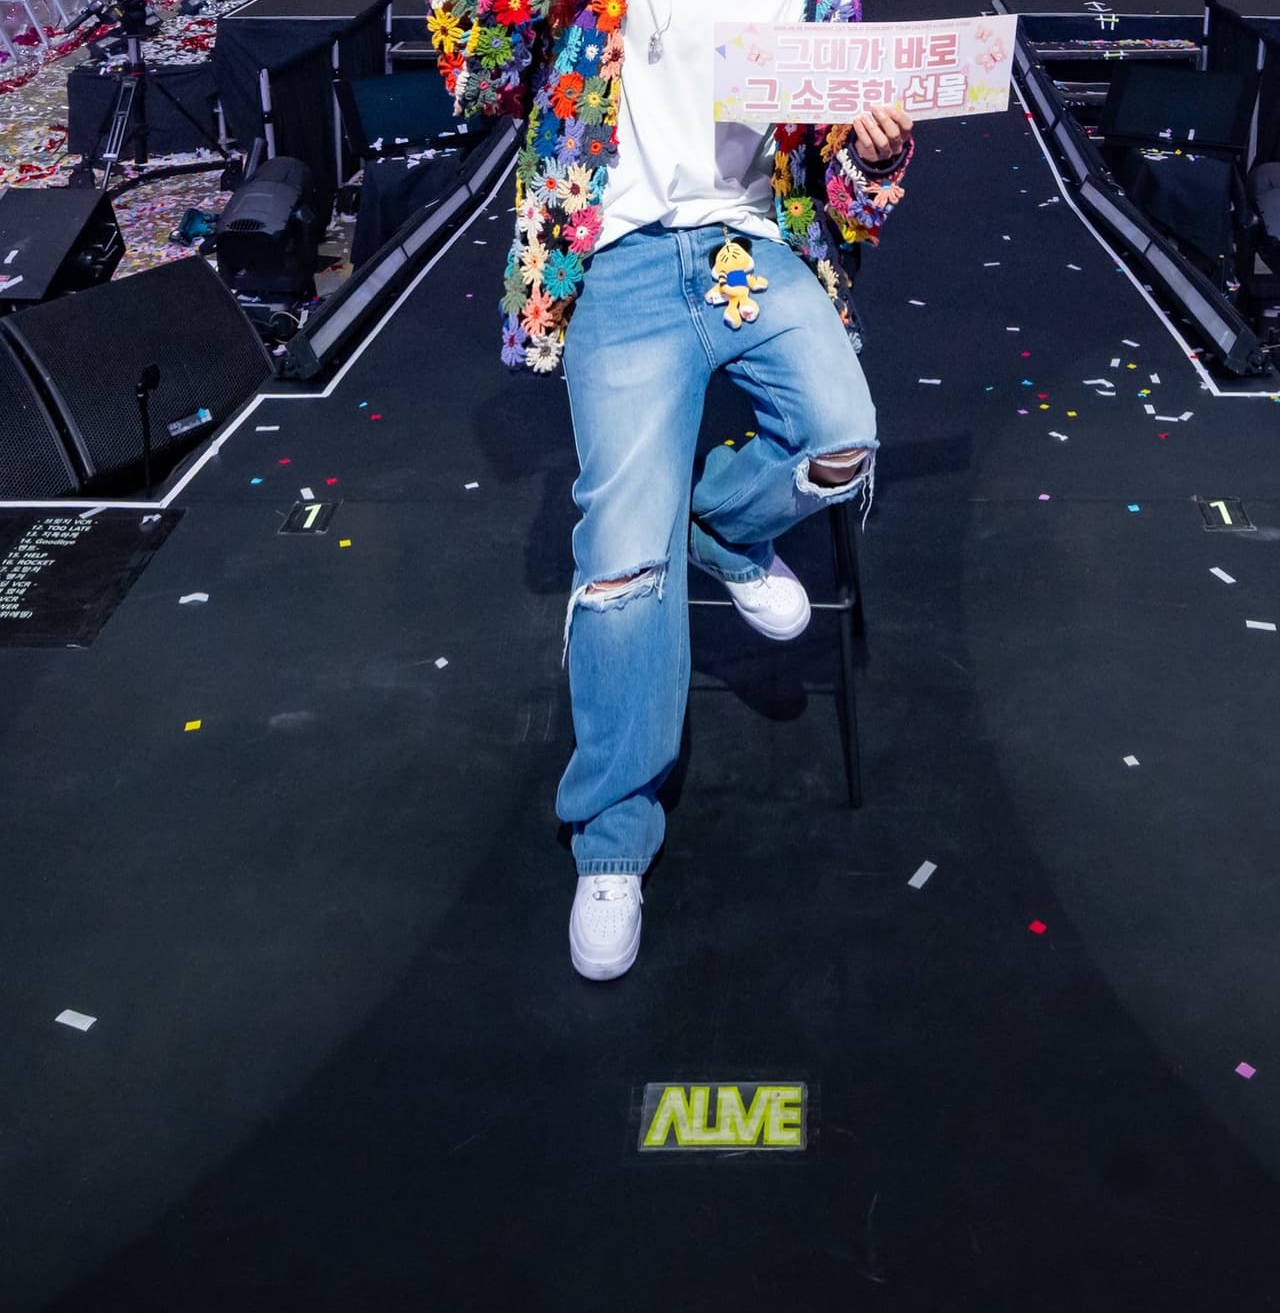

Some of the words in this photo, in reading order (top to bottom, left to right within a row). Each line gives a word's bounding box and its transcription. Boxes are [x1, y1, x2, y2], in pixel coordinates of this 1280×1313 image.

[776, 35, 886, 72] 그대가
[892, 32, 960, 71] 바로
[744, 78, 780, 112] 그
[790, 77, 896, 113] 소중한
[902, 72, 969, 112] 선물
[302, 504, 323, 528] 1
[1210, 501, 1233, 526] 1
[643, 1086, 802, 1146] ALIVE
